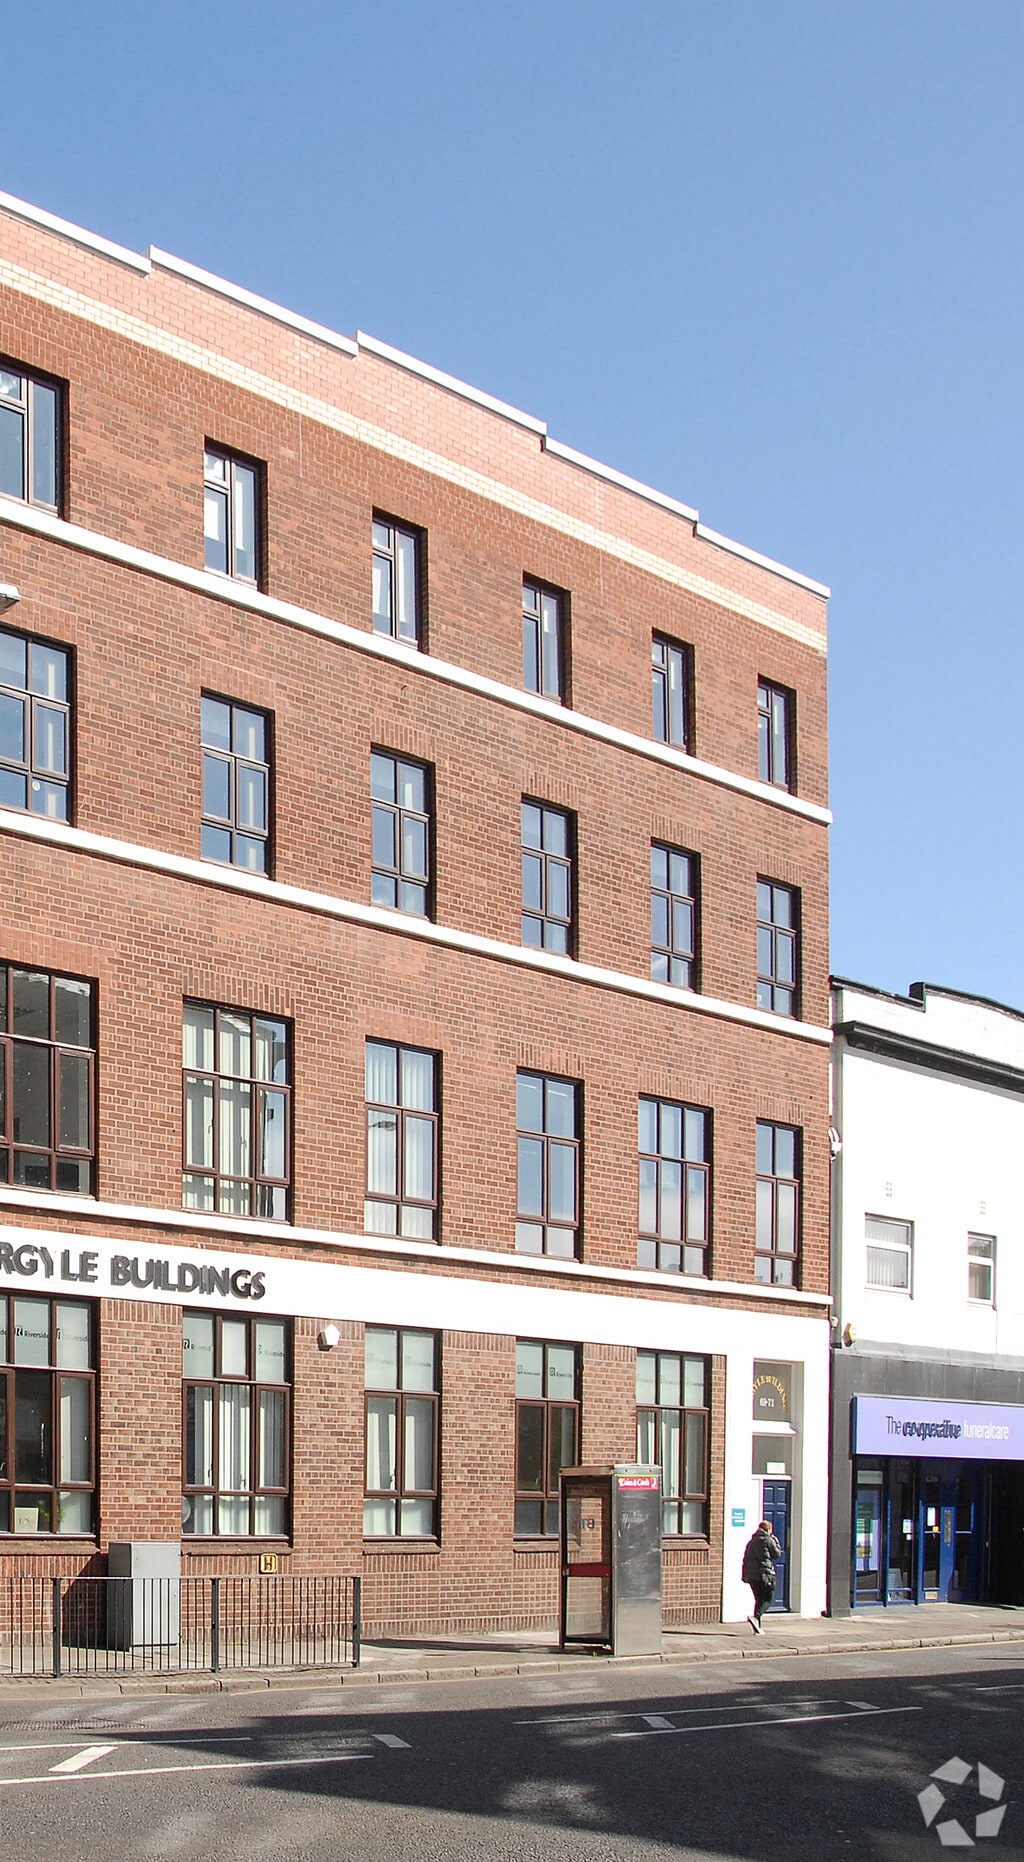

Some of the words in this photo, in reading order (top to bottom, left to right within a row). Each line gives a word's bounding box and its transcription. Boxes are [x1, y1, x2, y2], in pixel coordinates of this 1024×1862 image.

[110, 1255, 266, 1300] BUILDINGS
[886, 1416, 902, 1435] The
[963, 1420, 1009, 1440] funeralcare
